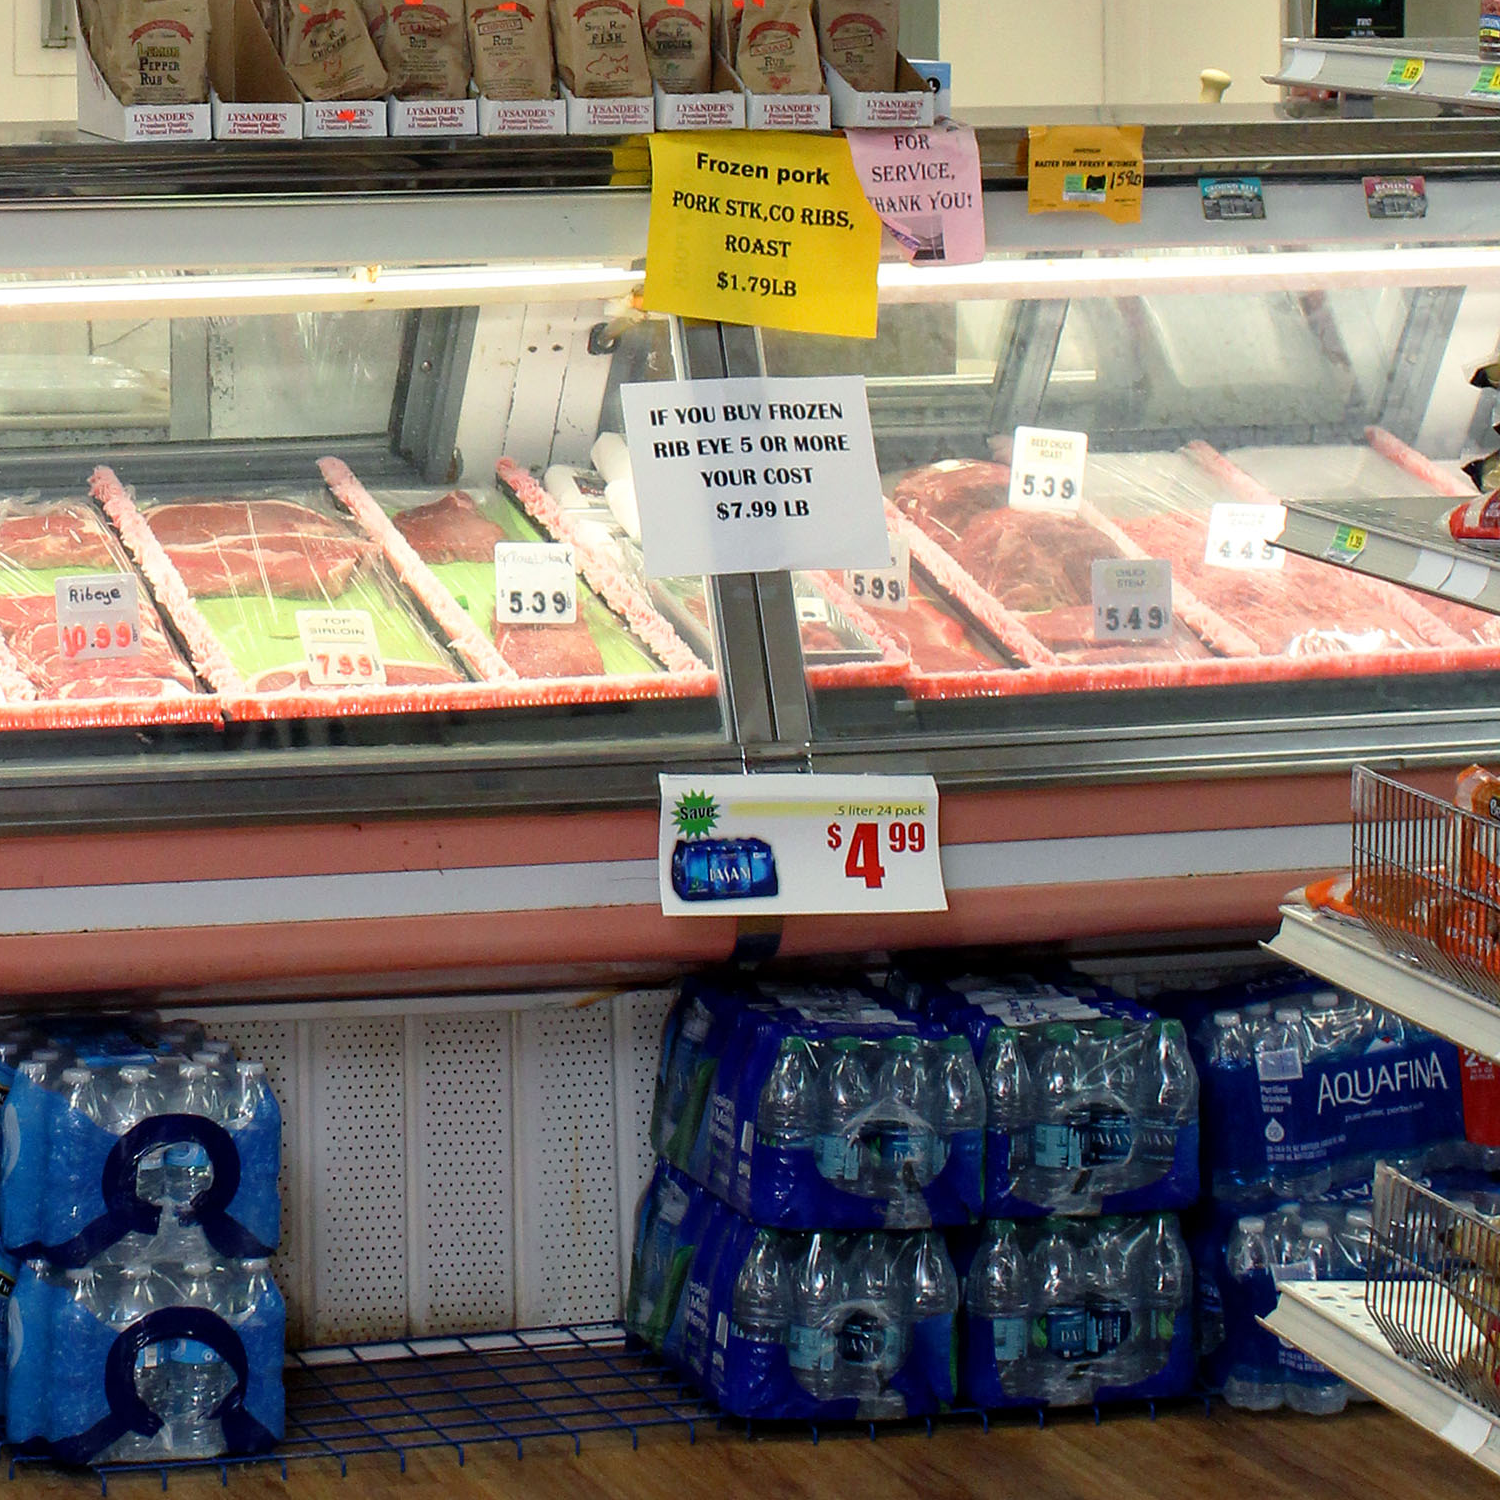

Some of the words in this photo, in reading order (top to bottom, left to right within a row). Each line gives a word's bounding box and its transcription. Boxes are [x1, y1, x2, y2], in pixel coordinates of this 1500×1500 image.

[406, 106, 465, 116] LYSANDER'S
[498, 108, 555, 118] LYSANDER'S
[587, 105, 649, 113] LYSANDER'S
[676, 103, 734, 112] LYSANDER'S
[763, 104, 821, 113] LYSANDER'S
[866, 99, 924, 108] LYSANDER'S
[134, 112, 194, 122] LYSANDER'S
[227, 112, 287, 122] LYSANDER'S
[894, 134, 930, 150] FOR
[697, 152, 768, 179] Frozen
[777, 167, 830, 186] pork
[872, 162, 956, 183] SERVICE,
[1374, 182, 1414, 191] ROUND
[928, 190, 973, 209] YOU!
[673, 191, 719, 214] PORK
[726, 200, 794, 223] STK,CO
[801, 207, 854, 230] RIBS,
[725, 235, 791, 257] ROAST
[717, 272, 797, 297] $1.79LB
[650, 409, 668, 426] IF
[675, 406, 716, 424] YOU
[723, 404, 765, 421] BUY
[769, 403, 843, 419] FROZEN
[653, 439, 690, 458] RIB
[696, 437, 734, 455] EYE
[740, 437, 753, 453] 5
[760, 436, 787, 452] OR
[794, 435, 850, 451] MORE
[701, 468, 757, 487] YOUR
[763, 467, 813, 484] COST
[1022, 474, 1075, 499] 5.39
[716, 500, 777, 521] $7.99
[784, 500, 810, 516] LB
[69, 586, 122, 605] Ribeye
[853, 573, 901, 602] 5.99
[509, 590, 566, 614] 5.39
[324, 618, 351, 626] TOP
[1106, 606, 1163, 631] 5.49
[316, 654, 373, 676] 7.99
[680, 805, 715, 820] Save
[848, 805, 874, 816] liter
[876, 805, 892, 816] 24
[895, 804, 926, 819] pack
[1317, 1051, 1448, 1114] AQUAFINA
